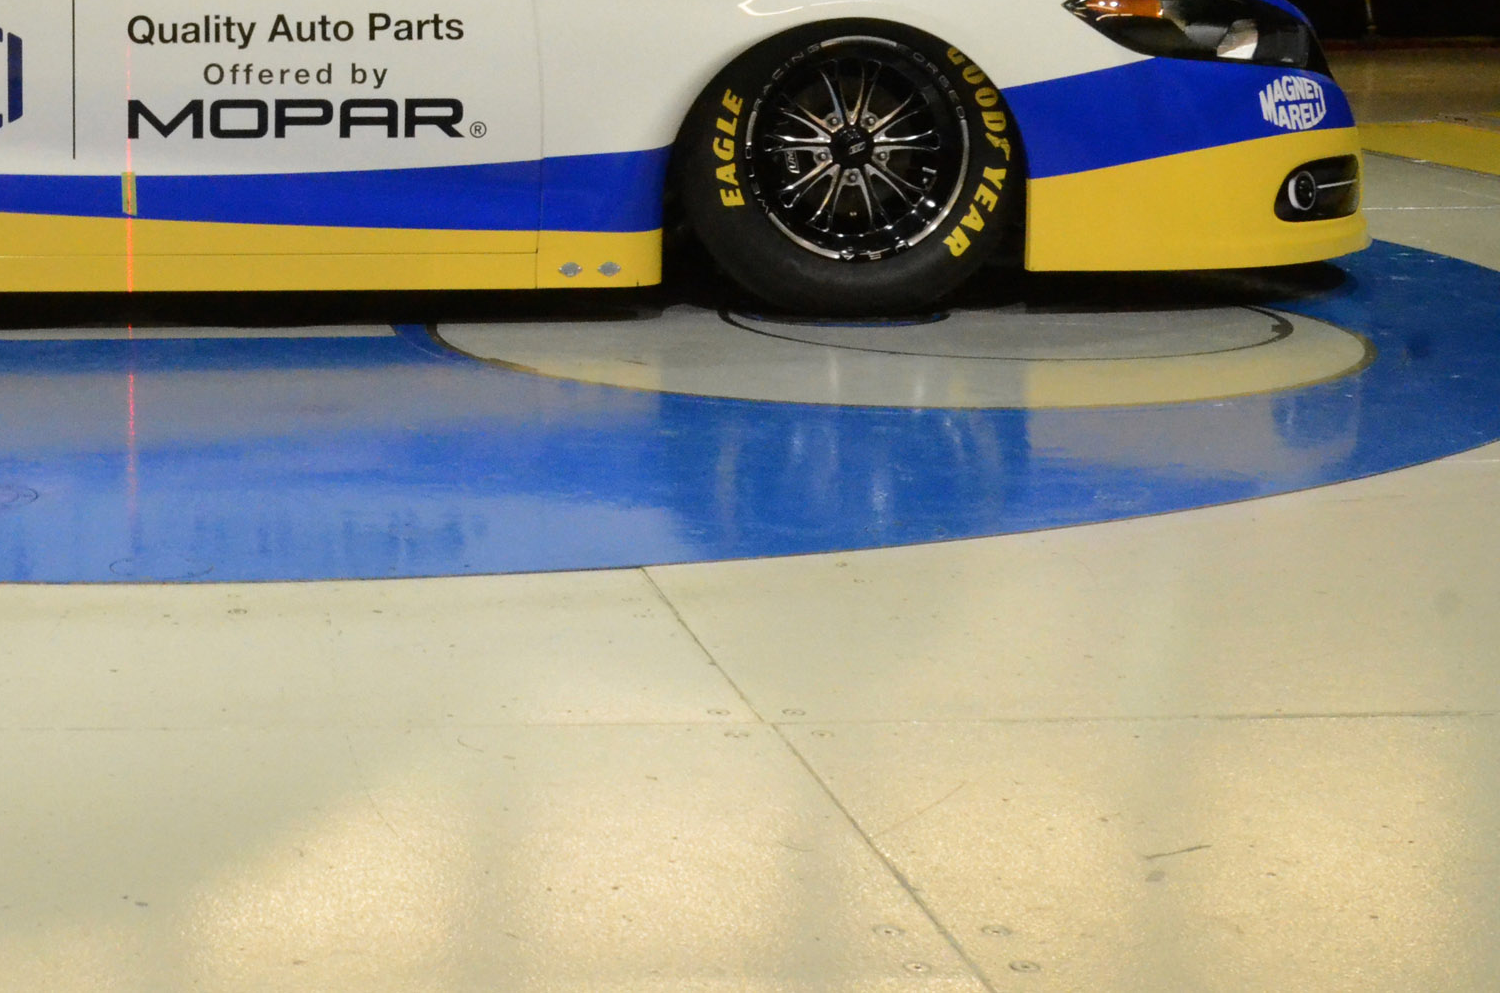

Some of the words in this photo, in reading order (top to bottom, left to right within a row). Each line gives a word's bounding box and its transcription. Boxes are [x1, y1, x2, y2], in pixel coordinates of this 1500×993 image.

[127, 15, 256, 49] Quality
[268, 14, 354, 42] Auto
[368, 12, 465, 41] Parts
[203, 62, 333, 85] Offered
[351, 62, 388, 89] by
[712, 88, 745, 207] EAGLE
